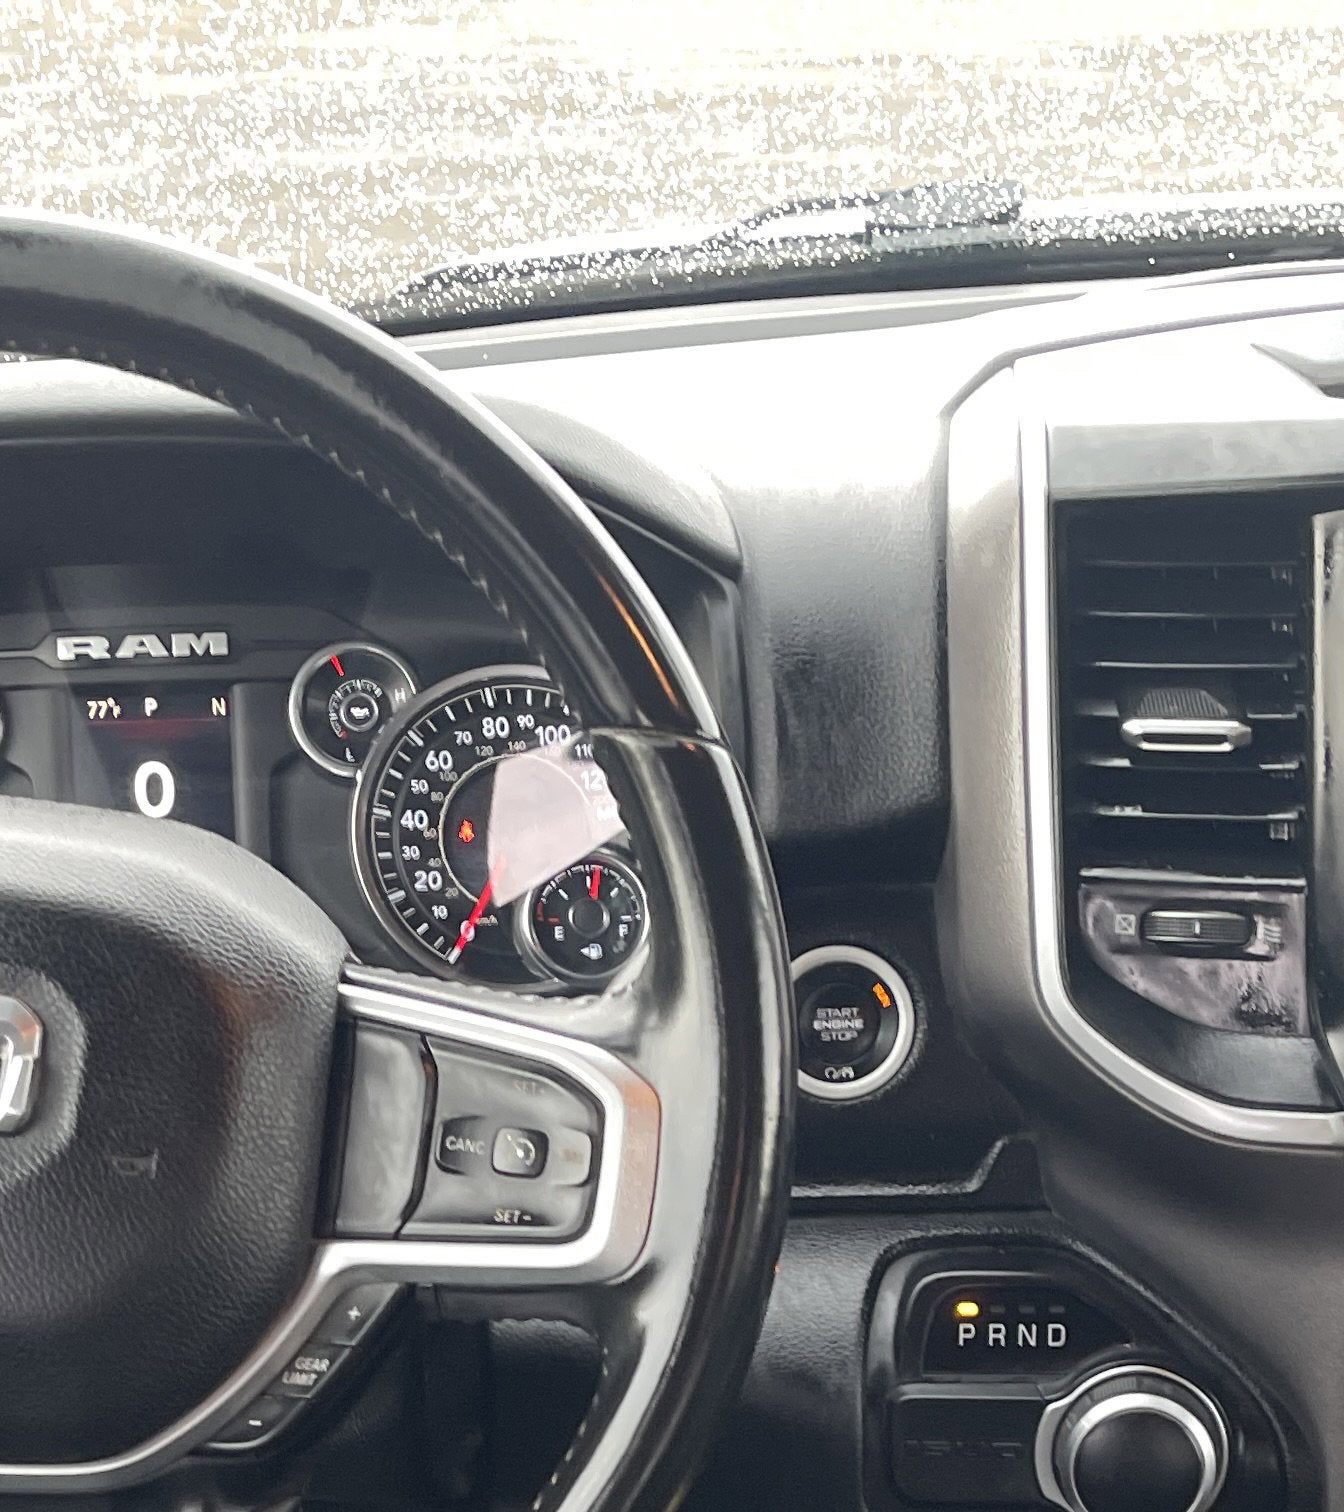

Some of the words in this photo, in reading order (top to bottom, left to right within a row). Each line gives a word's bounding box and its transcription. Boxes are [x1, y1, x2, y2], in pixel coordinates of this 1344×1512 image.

[56, 632, 229, 661] RAM
[144, 697, 158, 717] P
[210, 697, 227, 717] N
[482, 716, 510, 739] 80
[517, 714, 535, 730] 90
[455, 730, 473, 746] 70
[535, 725, 571, 746] 100
[425, 750, 453, 772] 60
[411, 779, 429, 795] 50
[581, 770, 608, 791] 12
[134, 760, 175, 819] 0
[401, 809, 428, 830] 40
[402, 846, 420, 860] 30
[414, 870, 442, 892] 20
[431, 905, 449, 920] 10
[554, 925, 565, 941] E
[619, 923, 628, 936] F
[817, 1007, 859, 1019] START
[813, 1019, 864, 1031] ENGINE
[821, 1031, 858, 1041] STOP
[445, 1136, 486, 1155] CANC
[958, 1323, 976, 1347] P
[988, 1323, 1006, 1347] R
[1017, 1323, 1038, 1347] N
[1048, 1323, 1068, 1347] D
[295, 1357, 330, 1372] GEAR
[282, 1371, 318, 1386] LIMIT
